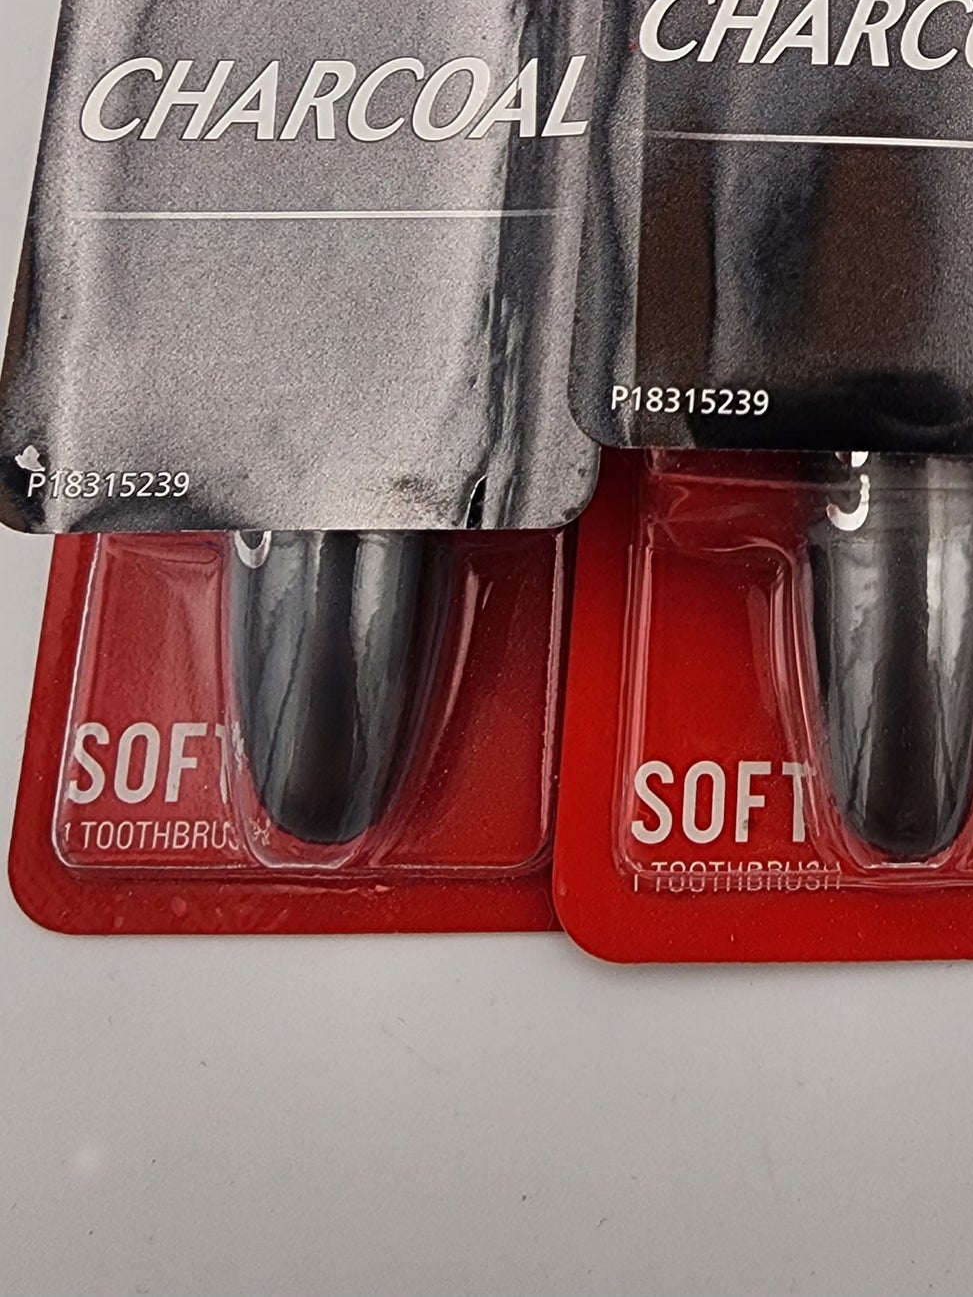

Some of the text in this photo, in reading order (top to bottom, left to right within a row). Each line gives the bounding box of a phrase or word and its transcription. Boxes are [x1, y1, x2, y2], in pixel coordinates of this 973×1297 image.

[80, 54, 593, 142] CHARCOAL
[610, 385, 770, 416] P18315239
[26, 471, 191, 498] P18315239
[631, 760, 816, 844] SOFT
[651, 860, 842, 893] TOOTHBRUSH
